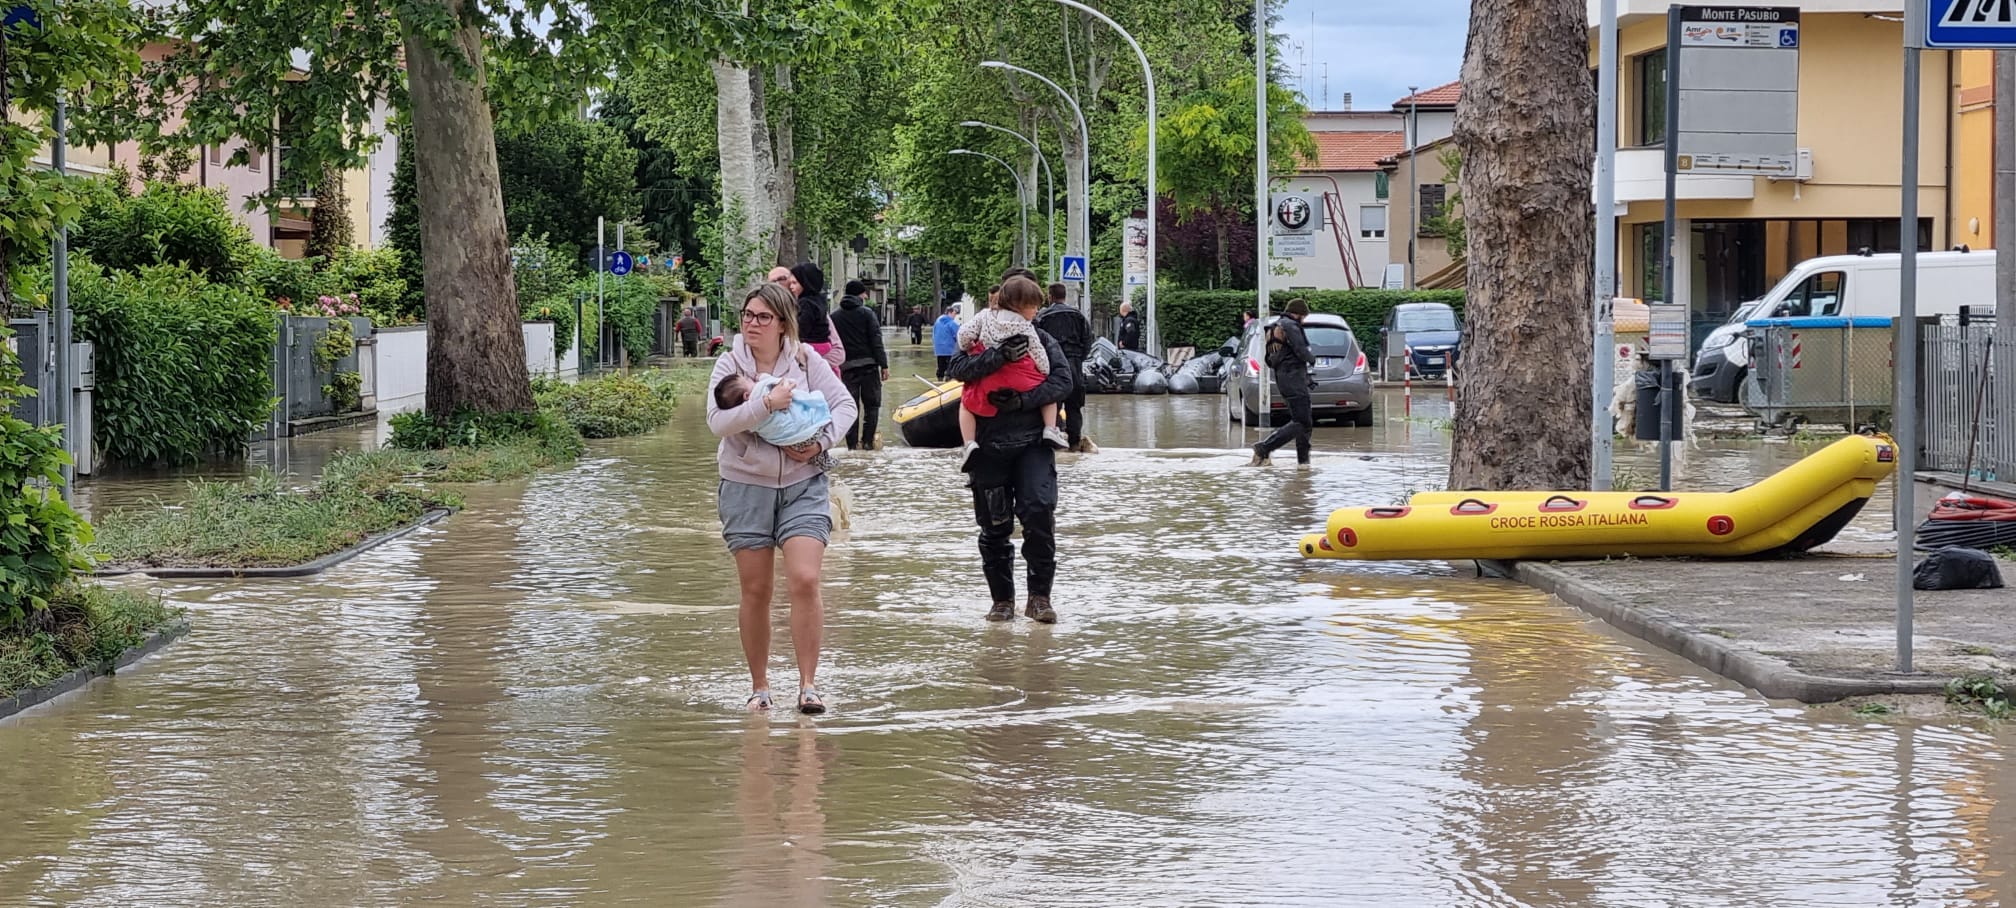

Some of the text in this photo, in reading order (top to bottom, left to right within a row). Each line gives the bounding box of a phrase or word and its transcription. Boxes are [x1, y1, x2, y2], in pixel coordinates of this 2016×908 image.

[1702, 8, 1780, 21] MONTE PASUBIO
[1490, 513, 1648, 528] CROCE ROSSA ITALIANA
